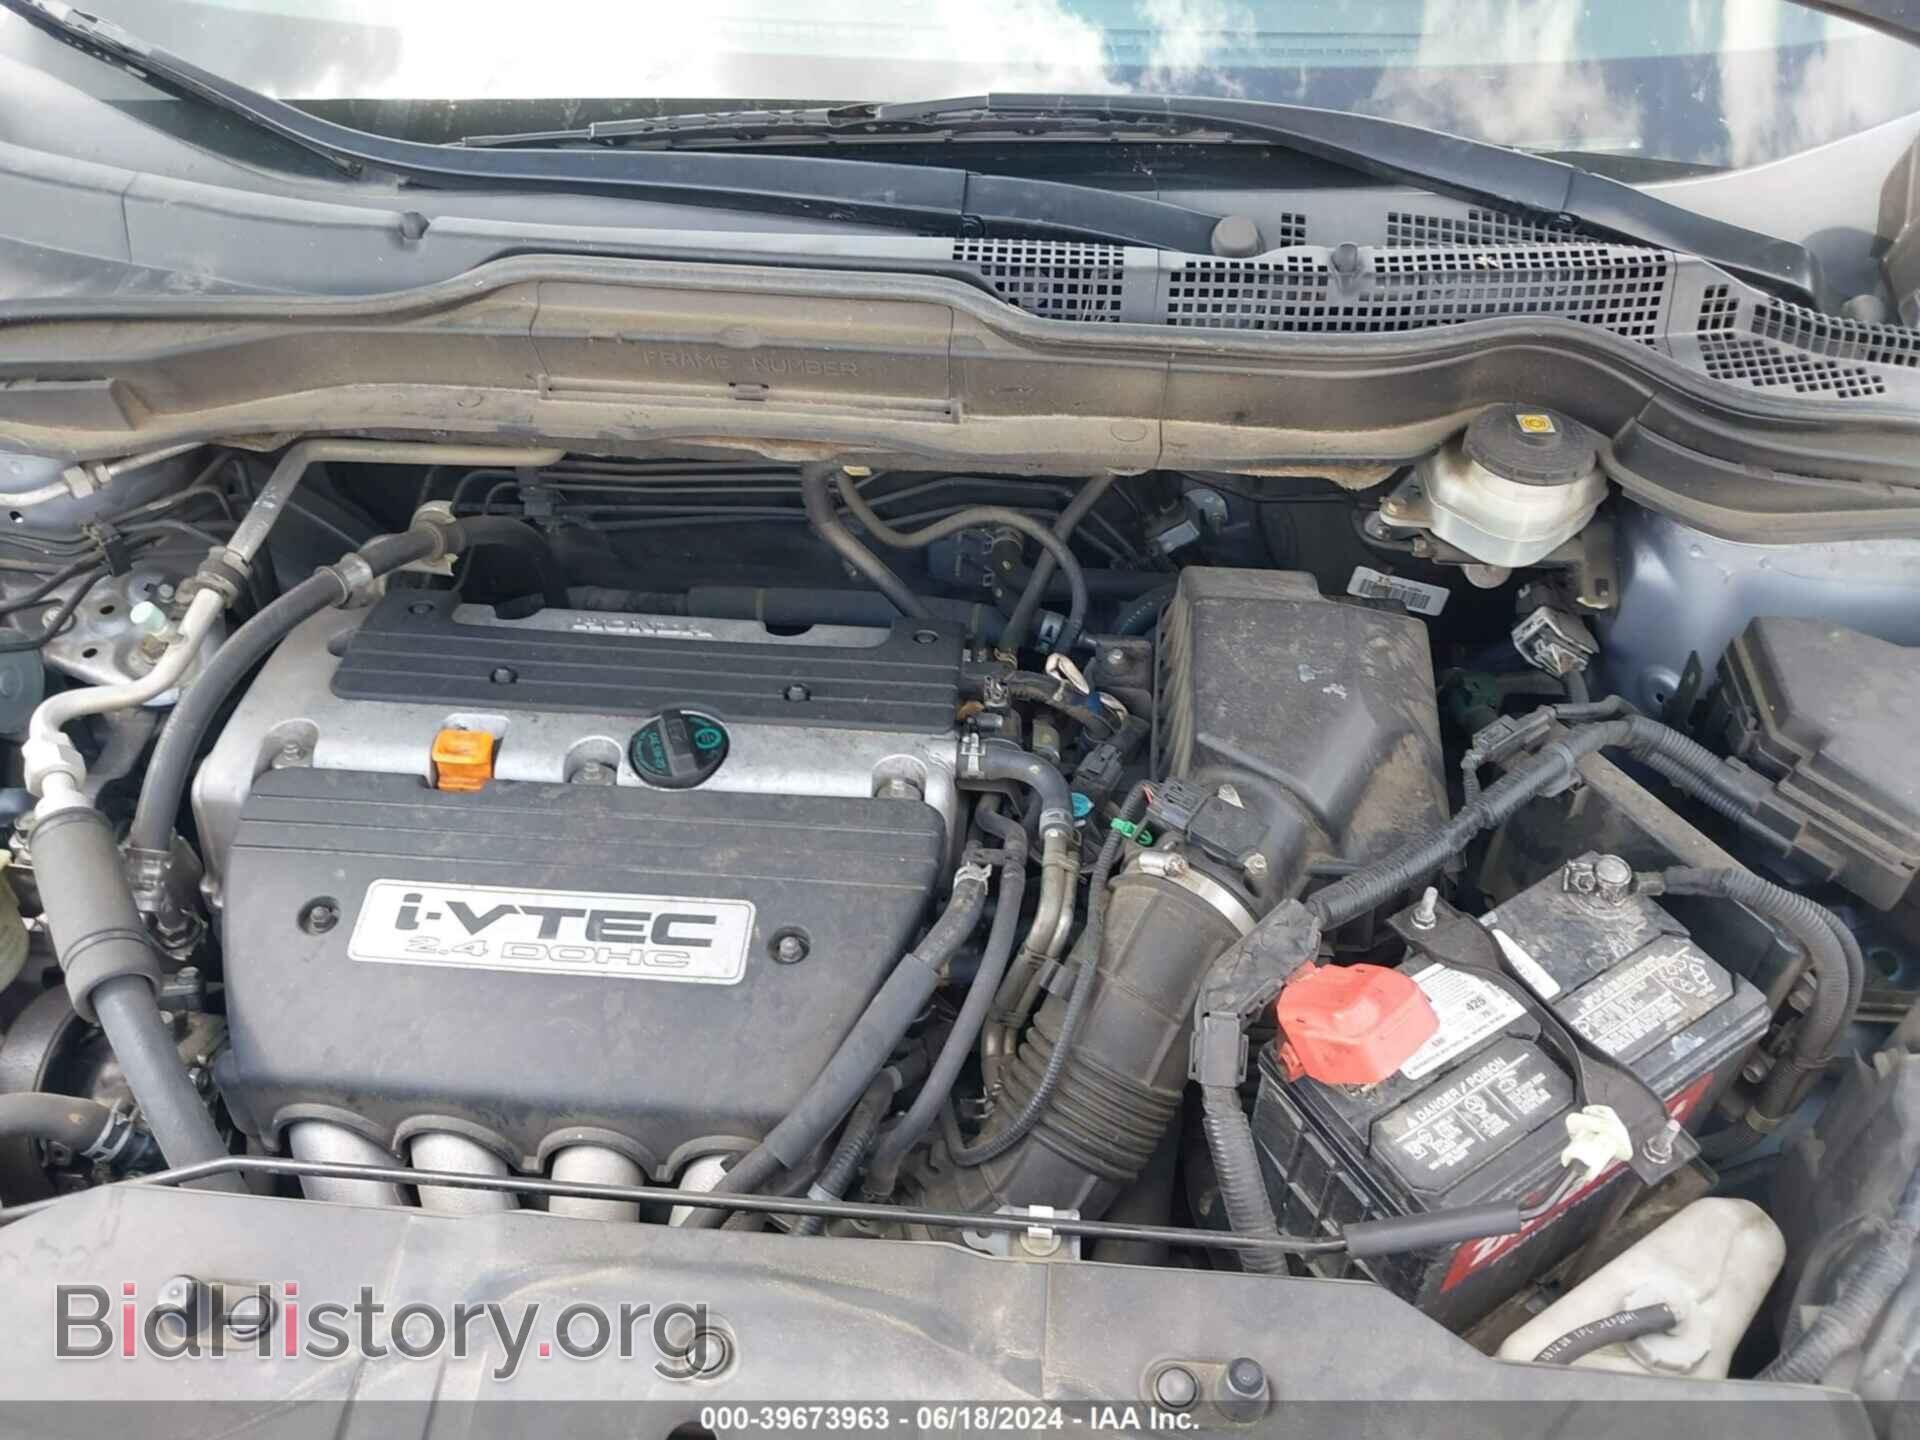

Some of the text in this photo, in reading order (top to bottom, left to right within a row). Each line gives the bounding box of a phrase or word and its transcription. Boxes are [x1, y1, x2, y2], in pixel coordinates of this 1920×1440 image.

[642, 352, 859, 377] FRAME NUMBER
[394, 892, 717, 948] i-VTEC
[404, 935, 692, 969] 2.4 DOHC
[1415, 1087, 1463, 1122] DANGER
[1465, 1056, 1507, 1089] POISON
